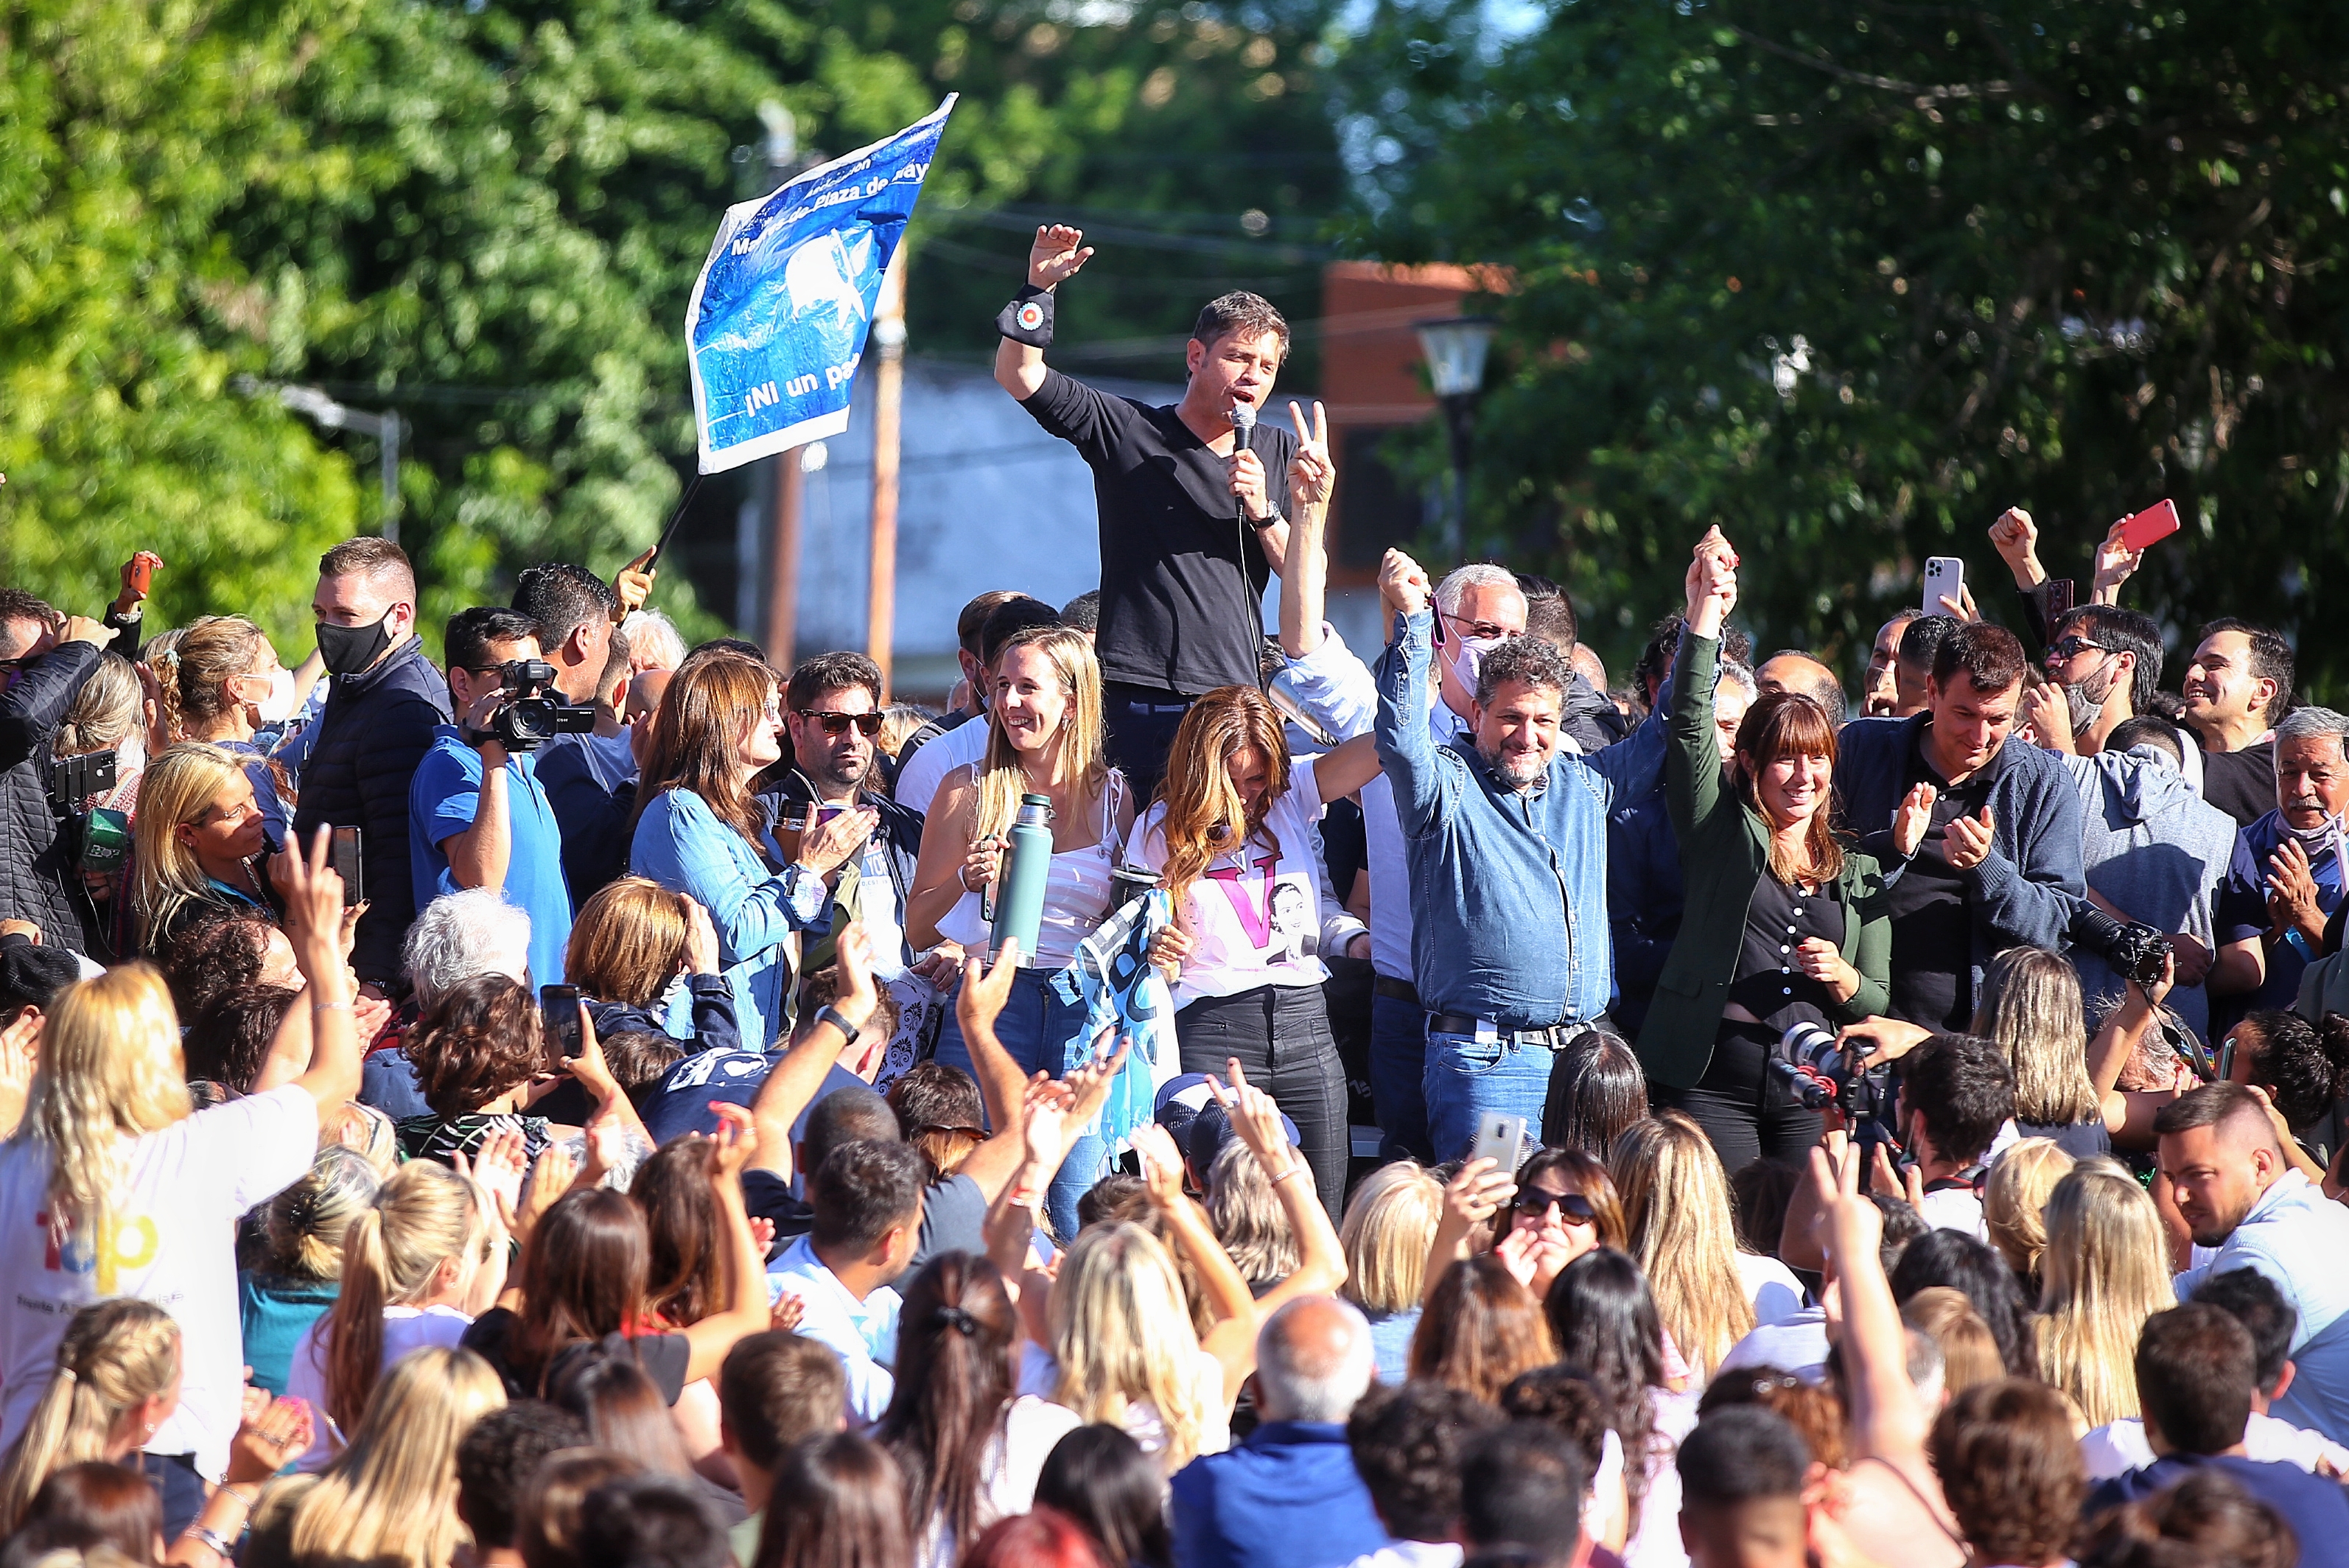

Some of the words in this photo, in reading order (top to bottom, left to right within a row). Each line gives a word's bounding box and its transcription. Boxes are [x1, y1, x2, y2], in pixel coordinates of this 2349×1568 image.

[788, 206, 810, 223] de
[813, 185, 861, 211] Plaza
[866, 176, 889, 195] de
[892, 161, 931, 183] ay
[785, 373, 819, 398] un
[1204, 850, 1284, 949] V
